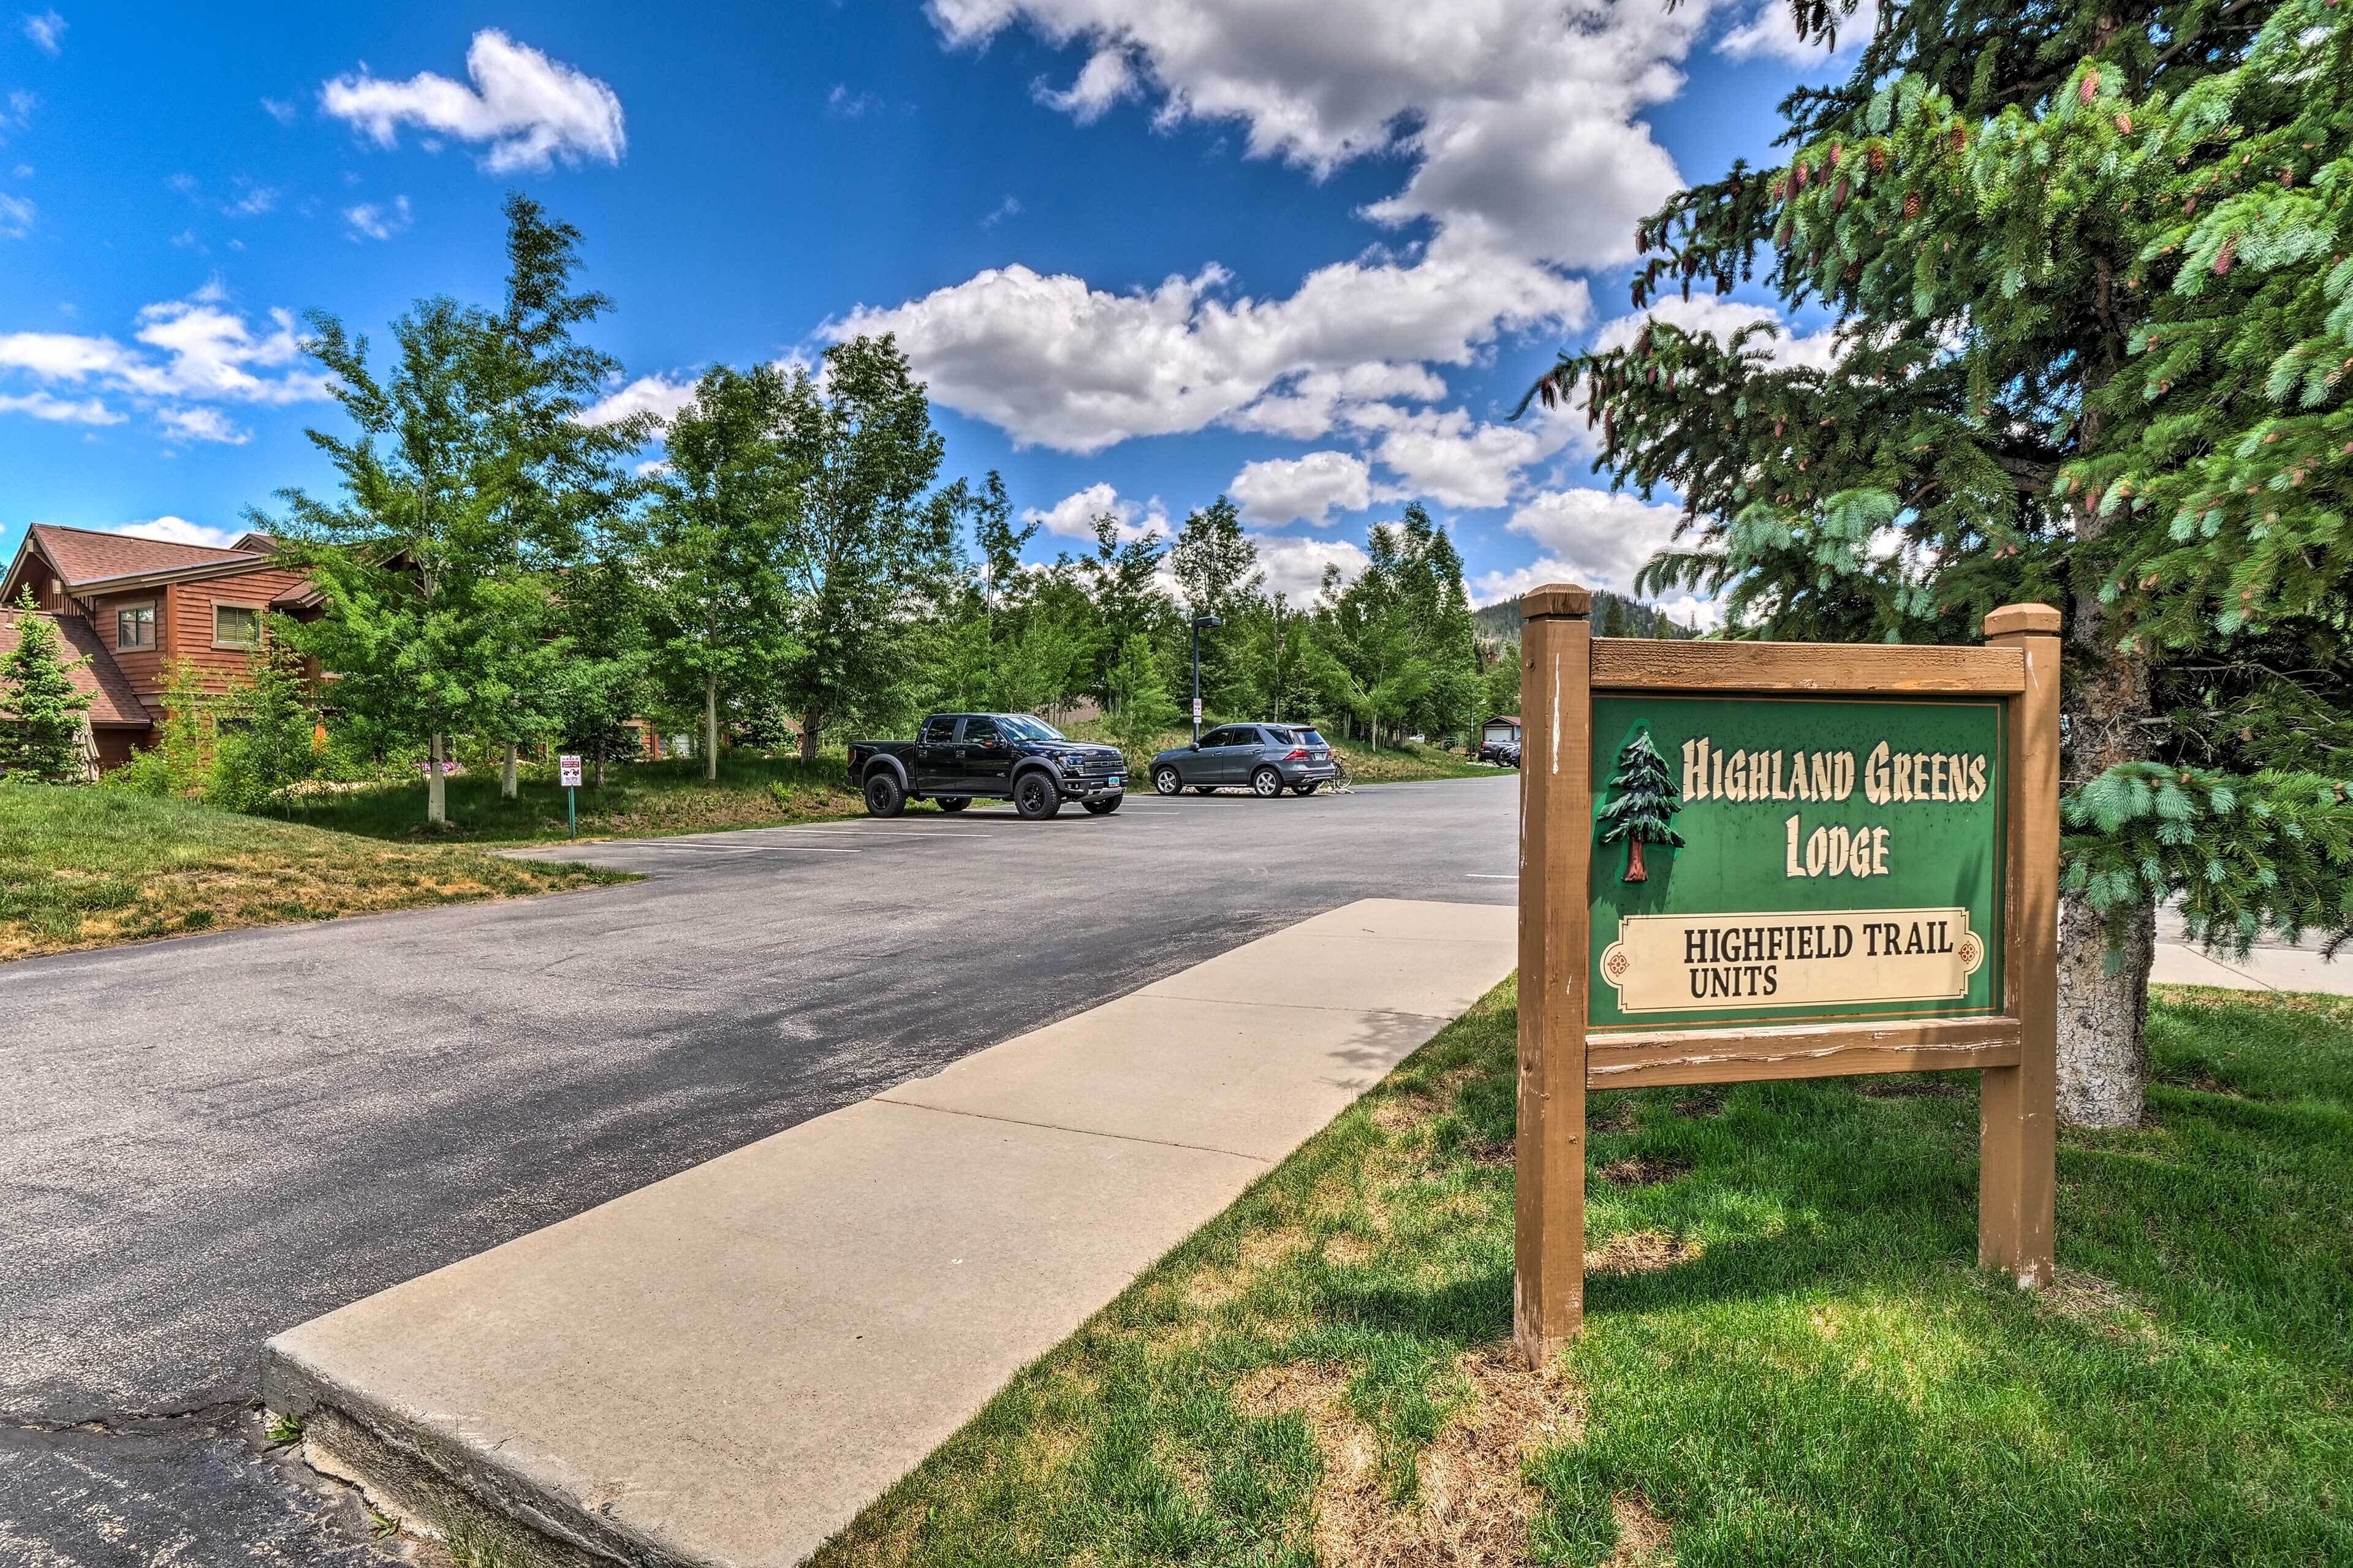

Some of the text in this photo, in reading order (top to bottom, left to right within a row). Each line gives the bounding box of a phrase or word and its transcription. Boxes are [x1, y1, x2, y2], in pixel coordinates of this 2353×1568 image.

[1681, 737, 1987, 805] HIGHLAND GREENS
[1786, 814, 1890, 878] LODGE
[1684, 921, 1954, 964] HIGHFIELD TRAIL
[1690, 965, 1778, 999] UNITS
